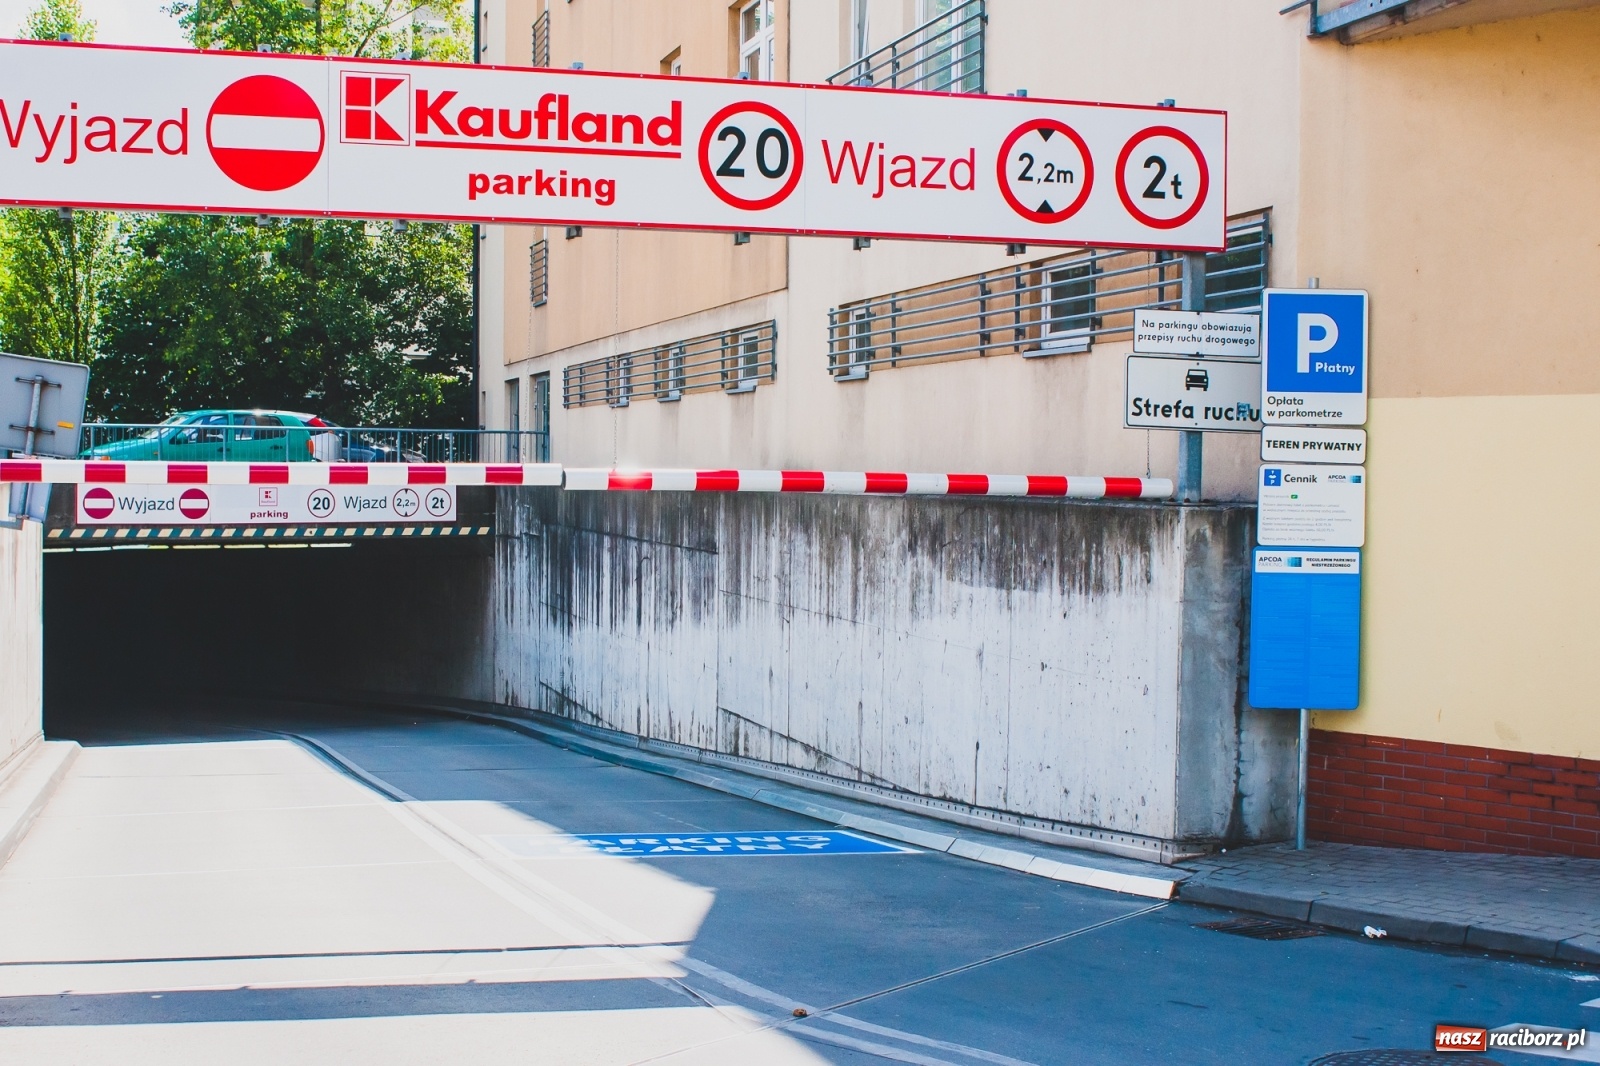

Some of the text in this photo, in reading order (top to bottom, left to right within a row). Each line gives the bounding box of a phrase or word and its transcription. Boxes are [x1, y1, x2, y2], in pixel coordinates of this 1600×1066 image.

[415, 89, 682, 147] Kaufland
[716, 126, 790, 179] 20
[821, 139, 976, 198] Wjazd
[1017, 152, 1074, 185] 2,2m
[1142, 155, 1183, 201] 2t
[468, 169, 616, 207] parking
[1141, 320, 1155, 328] Na
[1158, 321, 1198, 333] parkingu
[1138, 333, 1256, 347] przepisy ruchu drogowego
[1296, 313, 1339, 374] P
[1315, 362, 1356, 375] Płatny
[1131, 397, 1195, 419] Strefa
[1267, 396, 1304, 407] Opłata
[1278, 408, 1343, 419] parkometrze
[1266, 439, 1362, 451] TEREN PRYWATNY
[1284, 474, 1318, 483] Cennik
[118, 496, 175, 513] Wyjazd
[312, 497, 330, 510] 20
[343, 496, 387, 513] Wjazd
[432, 497, 445, 509] 2t
[250, 510, 289, 520] parking
